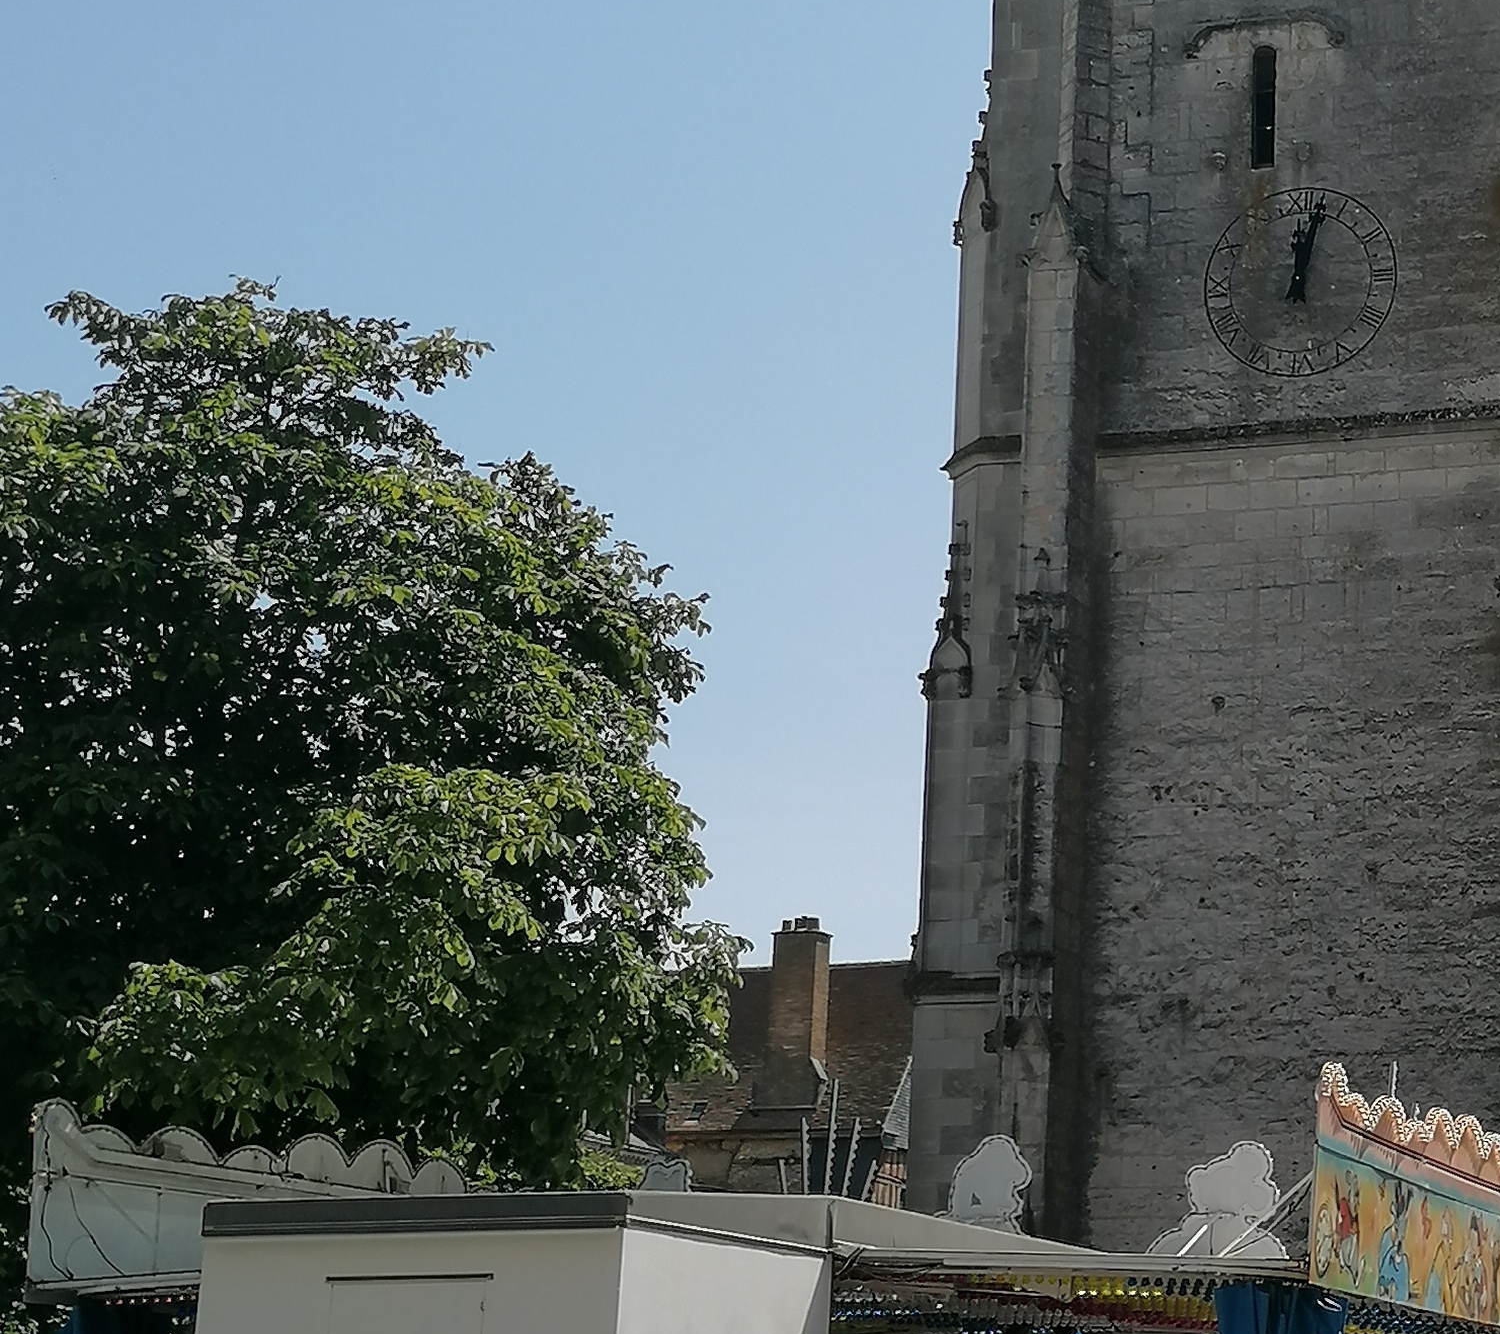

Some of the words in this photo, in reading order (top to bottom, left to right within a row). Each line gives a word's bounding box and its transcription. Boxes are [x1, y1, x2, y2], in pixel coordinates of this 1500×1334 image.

[1287, 191, 1314, 213] XII
[1362, 226, 1383, 244] II
[1373, 268, 1393, 283] III
[1335, 342, 1355, 362] V
